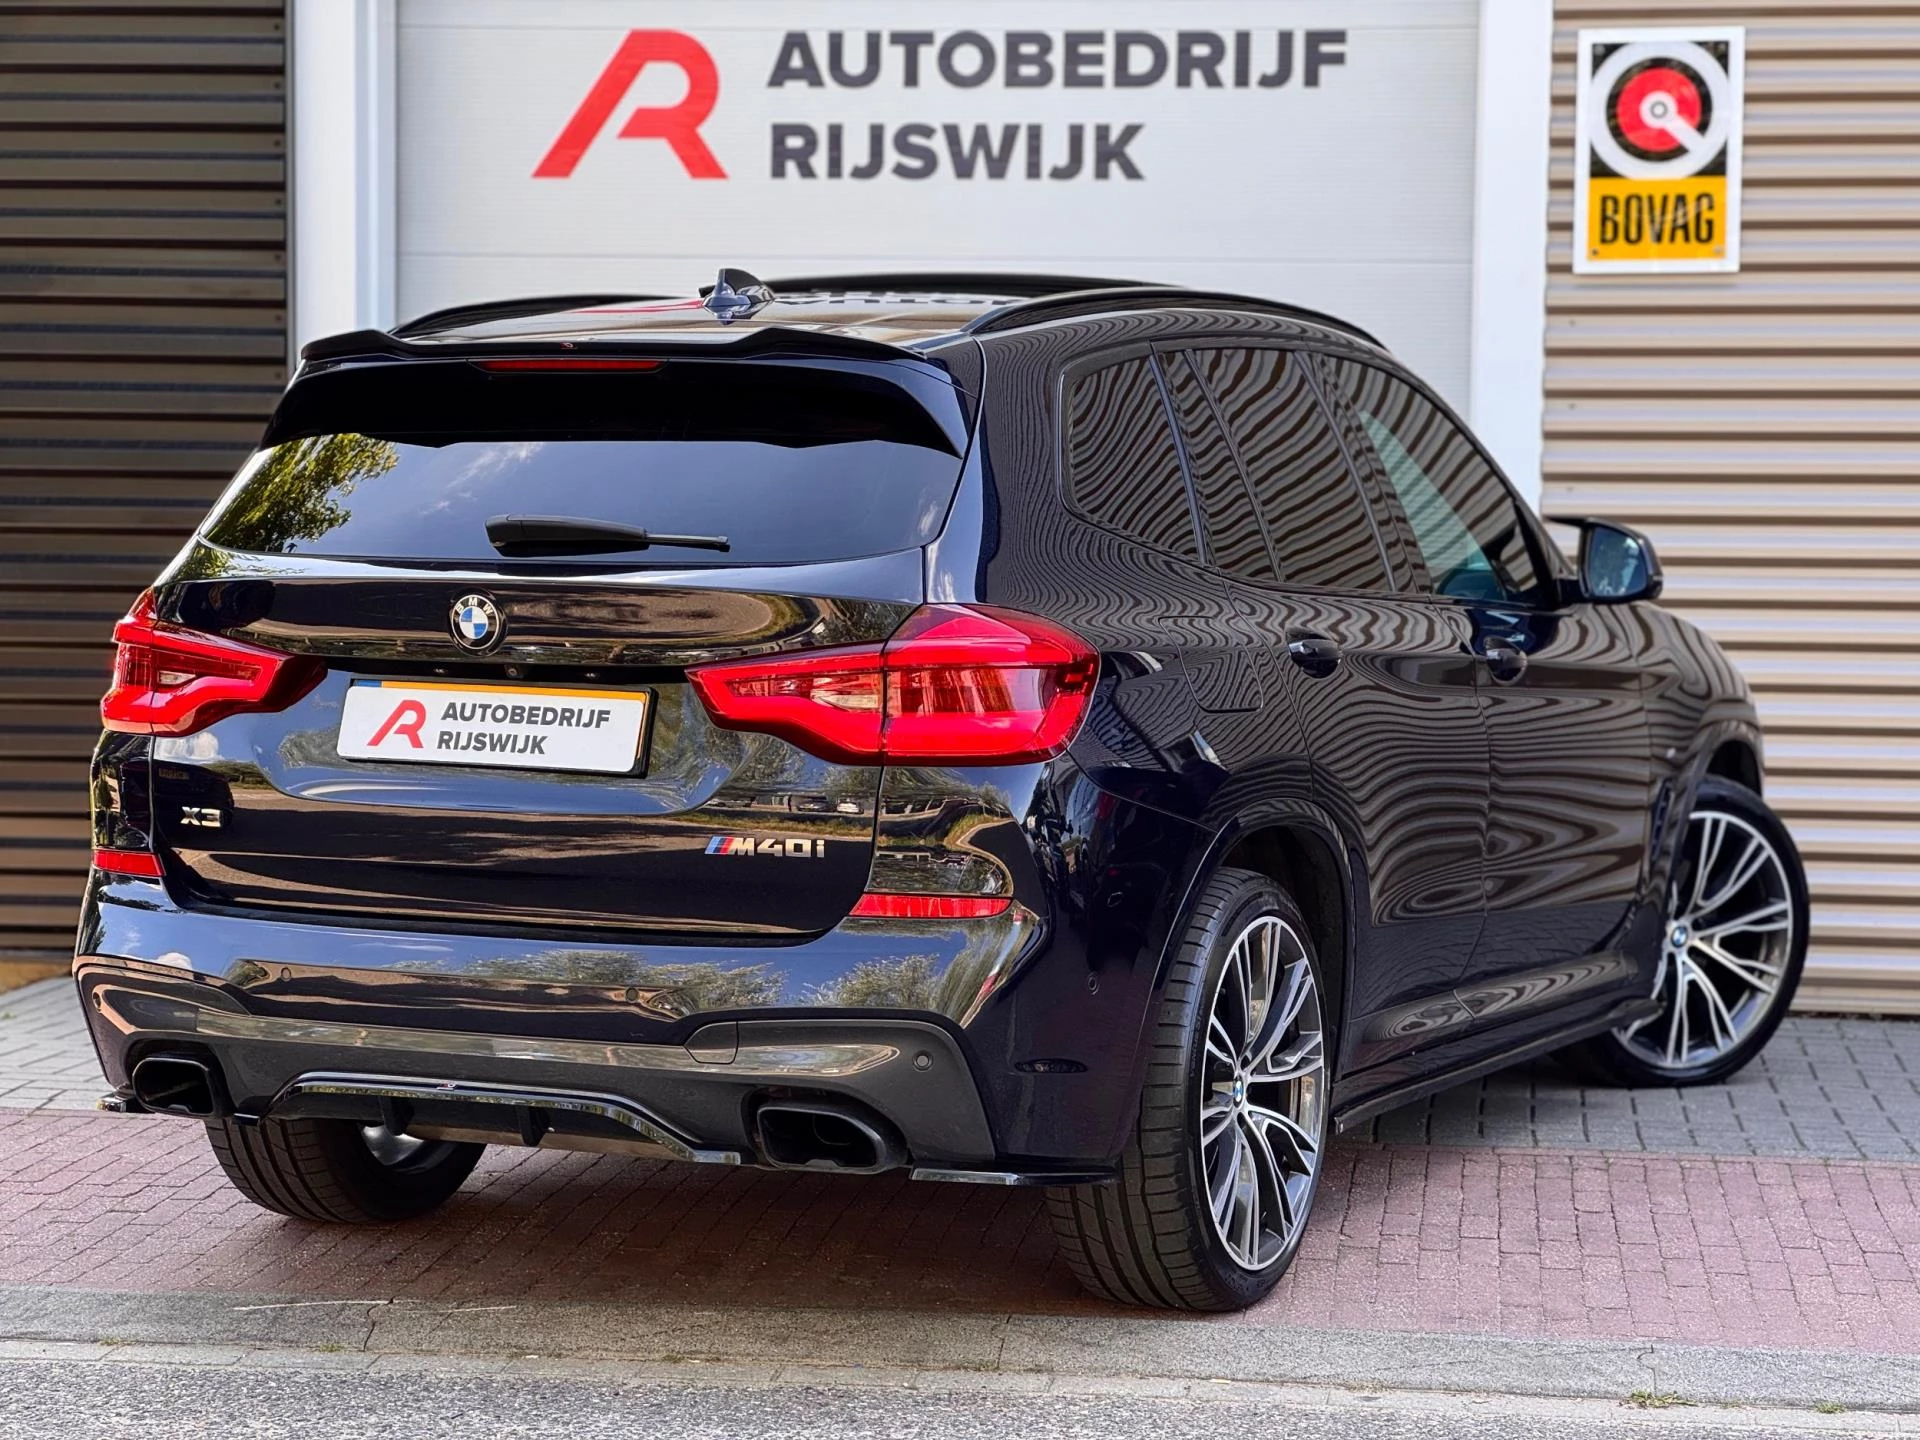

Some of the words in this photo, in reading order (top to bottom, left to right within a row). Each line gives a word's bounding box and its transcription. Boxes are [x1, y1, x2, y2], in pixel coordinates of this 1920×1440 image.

[767, 29, 1348, 89] AUTOBEDRIJF
[771, 123, 1144, 181] RIJSWIJK
[1599, 192, 1715, 245] BOVAG
[455, 597, 494, 616] BMW
[441, 702, 611, 729] AUTOBEDRIJF
[436, 730, 548, 755] RIJSWIJK
[180, 806, 222, 828] X3
[727, 836, 825, 858] M40i
